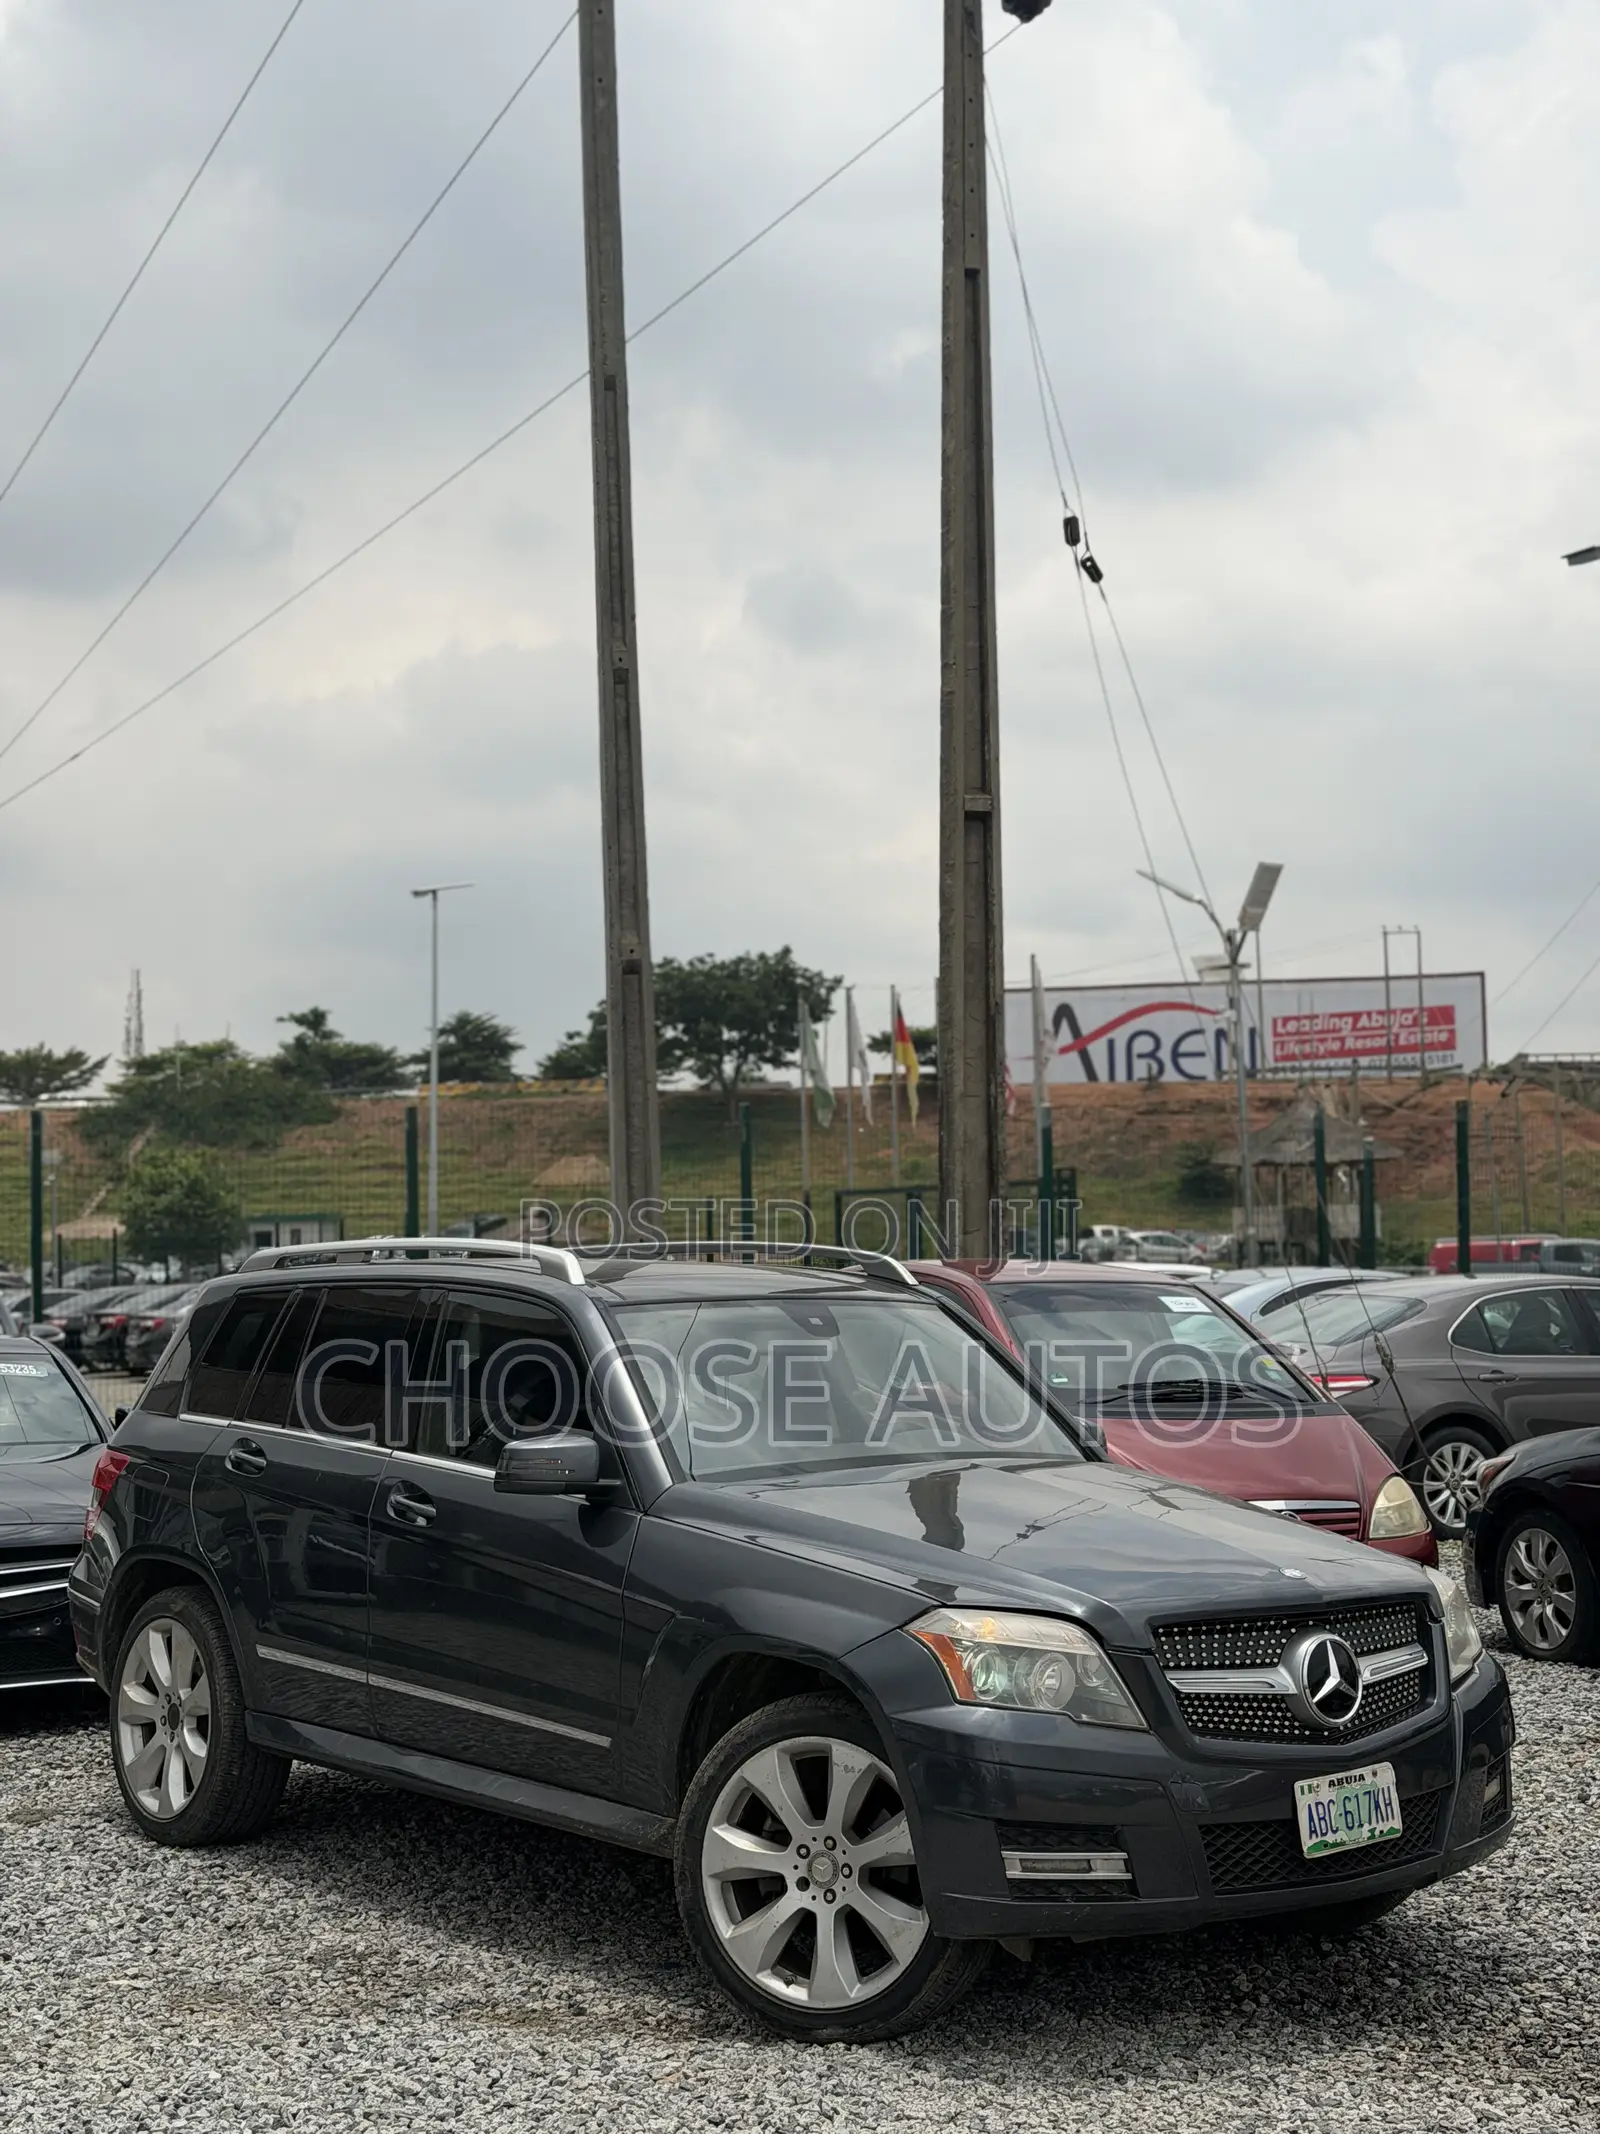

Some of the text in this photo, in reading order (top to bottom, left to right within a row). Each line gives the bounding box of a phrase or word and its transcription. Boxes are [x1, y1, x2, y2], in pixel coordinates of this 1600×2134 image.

[1276, 1009, 1429, 1034] Leading Abuja's
[1275, 1029, 1450, 1056] Lifestyle Resort Estate
[1328, 1773, 1366, 1788] ABUJA
[1307, 1785, 1395, 1840] ABC-617KH
